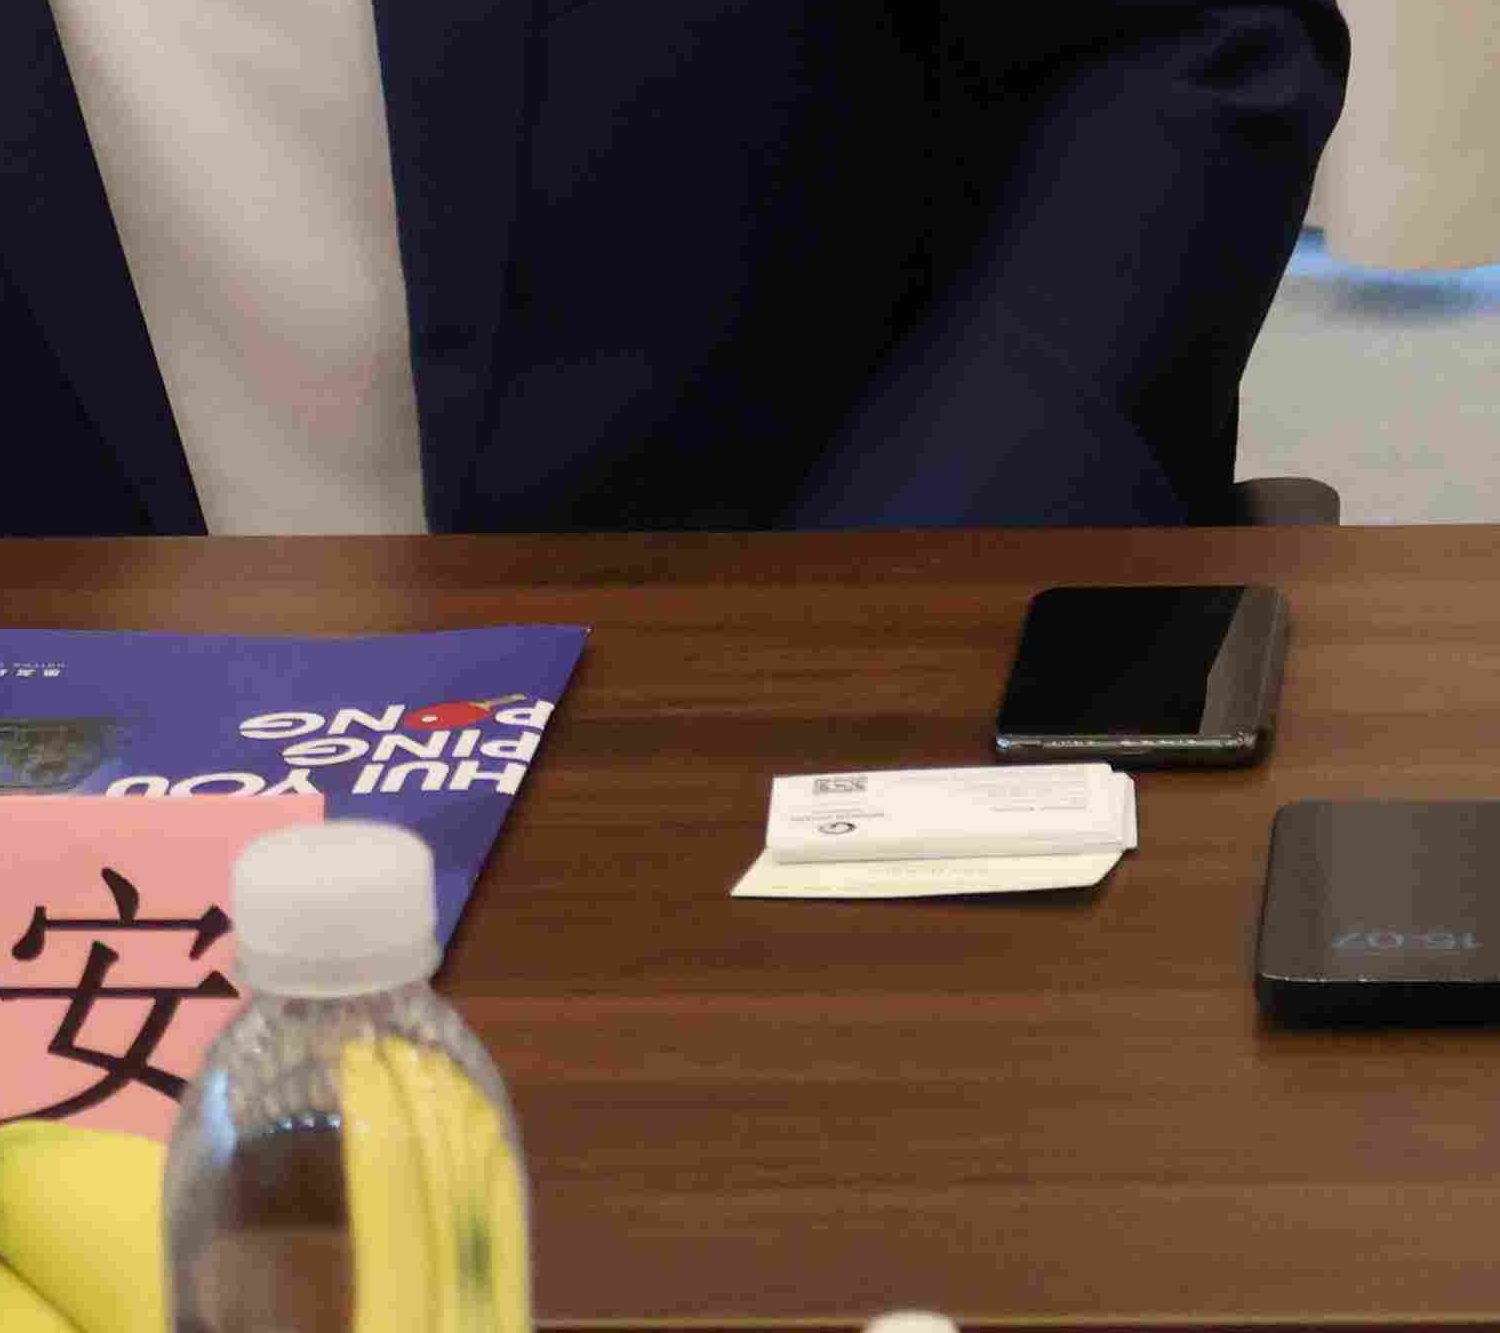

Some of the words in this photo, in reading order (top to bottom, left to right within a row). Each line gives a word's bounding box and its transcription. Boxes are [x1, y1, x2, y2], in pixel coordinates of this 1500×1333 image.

[282, 728, 544, 766] PING
[105, 769, 320, 797] YOU
[352, 761, 528, 796] HUI
